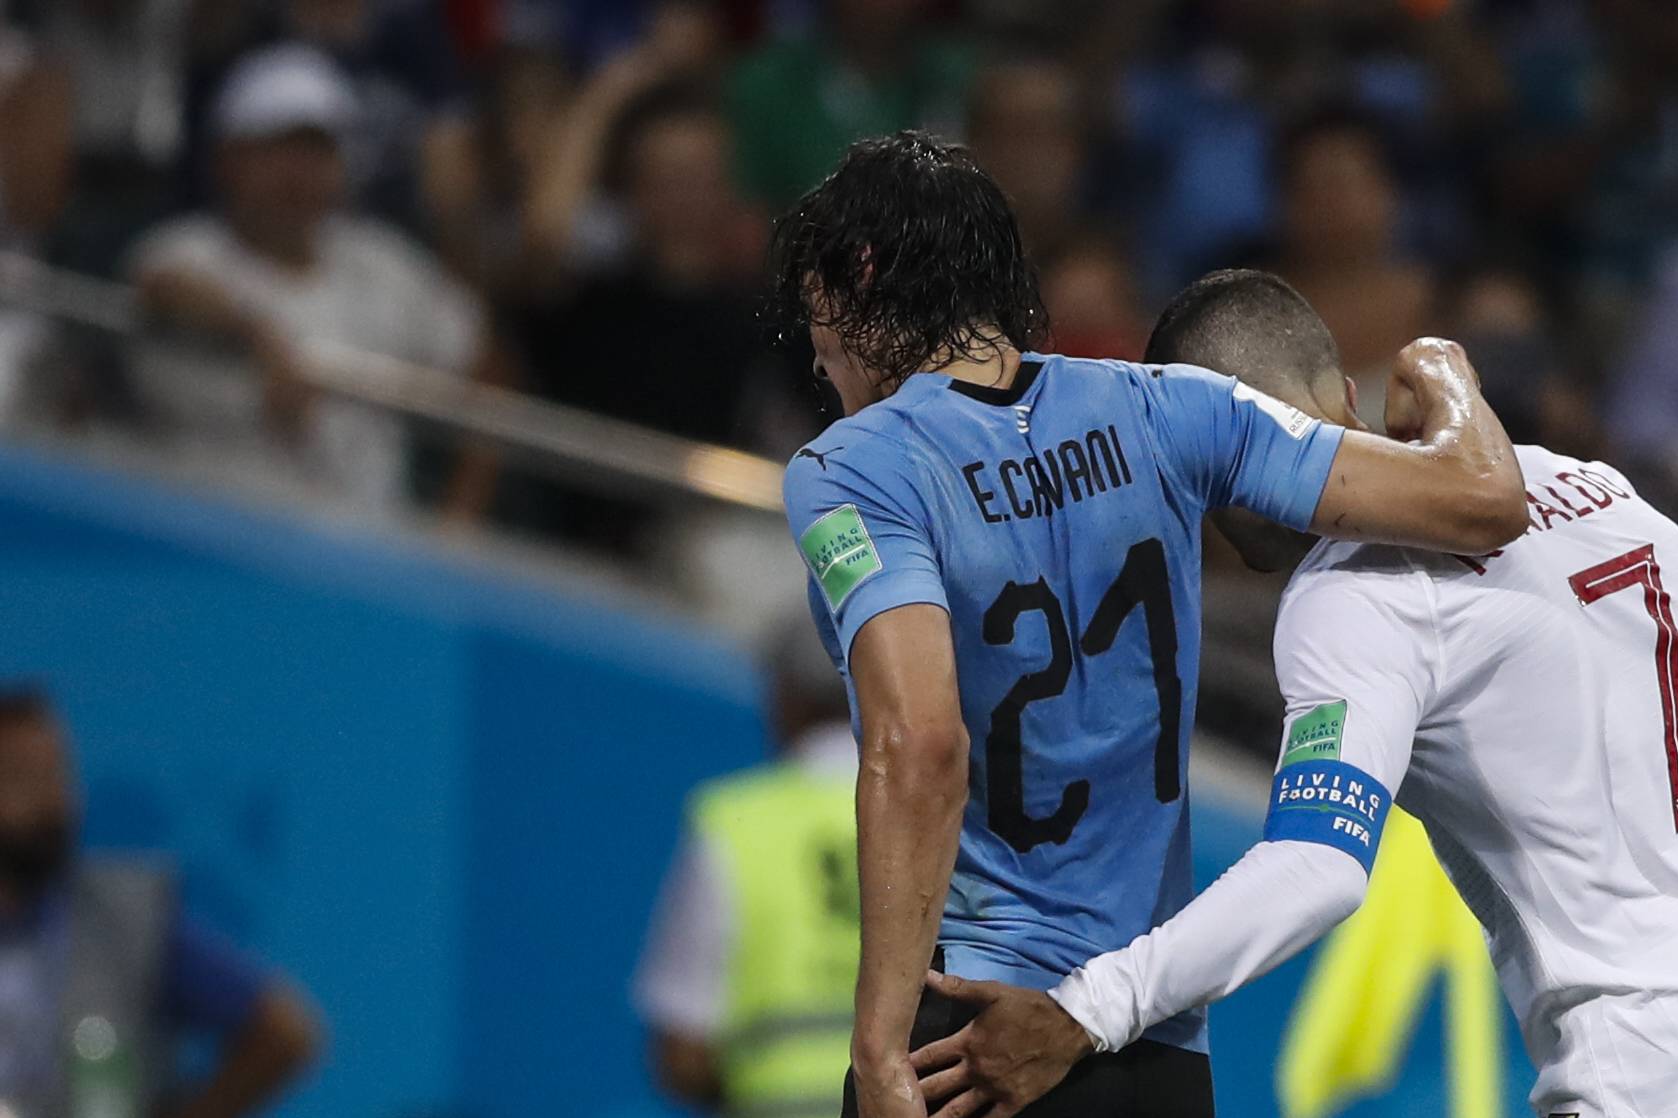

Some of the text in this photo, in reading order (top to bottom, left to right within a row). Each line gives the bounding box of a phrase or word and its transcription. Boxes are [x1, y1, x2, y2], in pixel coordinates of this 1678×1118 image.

[962, 424, 1132, 523] E.CAVANI
[846, 549, 869, 566] FIFA
[983, 537, 1181, 854] 21
[1313, 742, 1336, 752] FIFA
[1279, 787, 1376, 822] FOOTBALL
[1281, 773, 1381, 809] LIVING
[1332, 816, 1372, 847] FIFA
